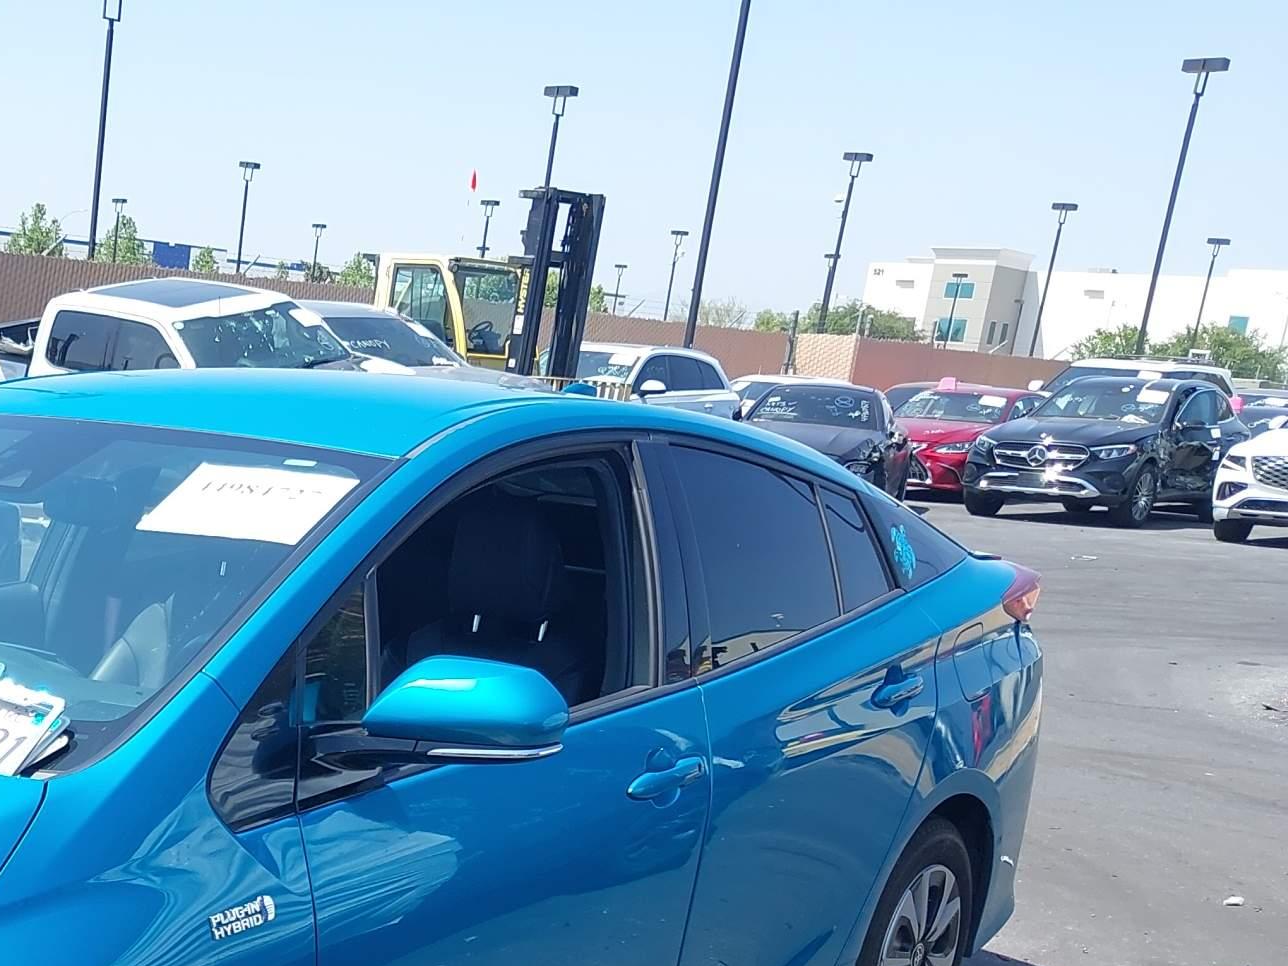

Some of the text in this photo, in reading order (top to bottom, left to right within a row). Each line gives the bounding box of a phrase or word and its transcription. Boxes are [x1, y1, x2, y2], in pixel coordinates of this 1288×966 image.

[350, 338, 391, 350] CANOPY
[209, 899, 261, 928] PLUG-IN
[211, 913, 265, 940] HYBRID
